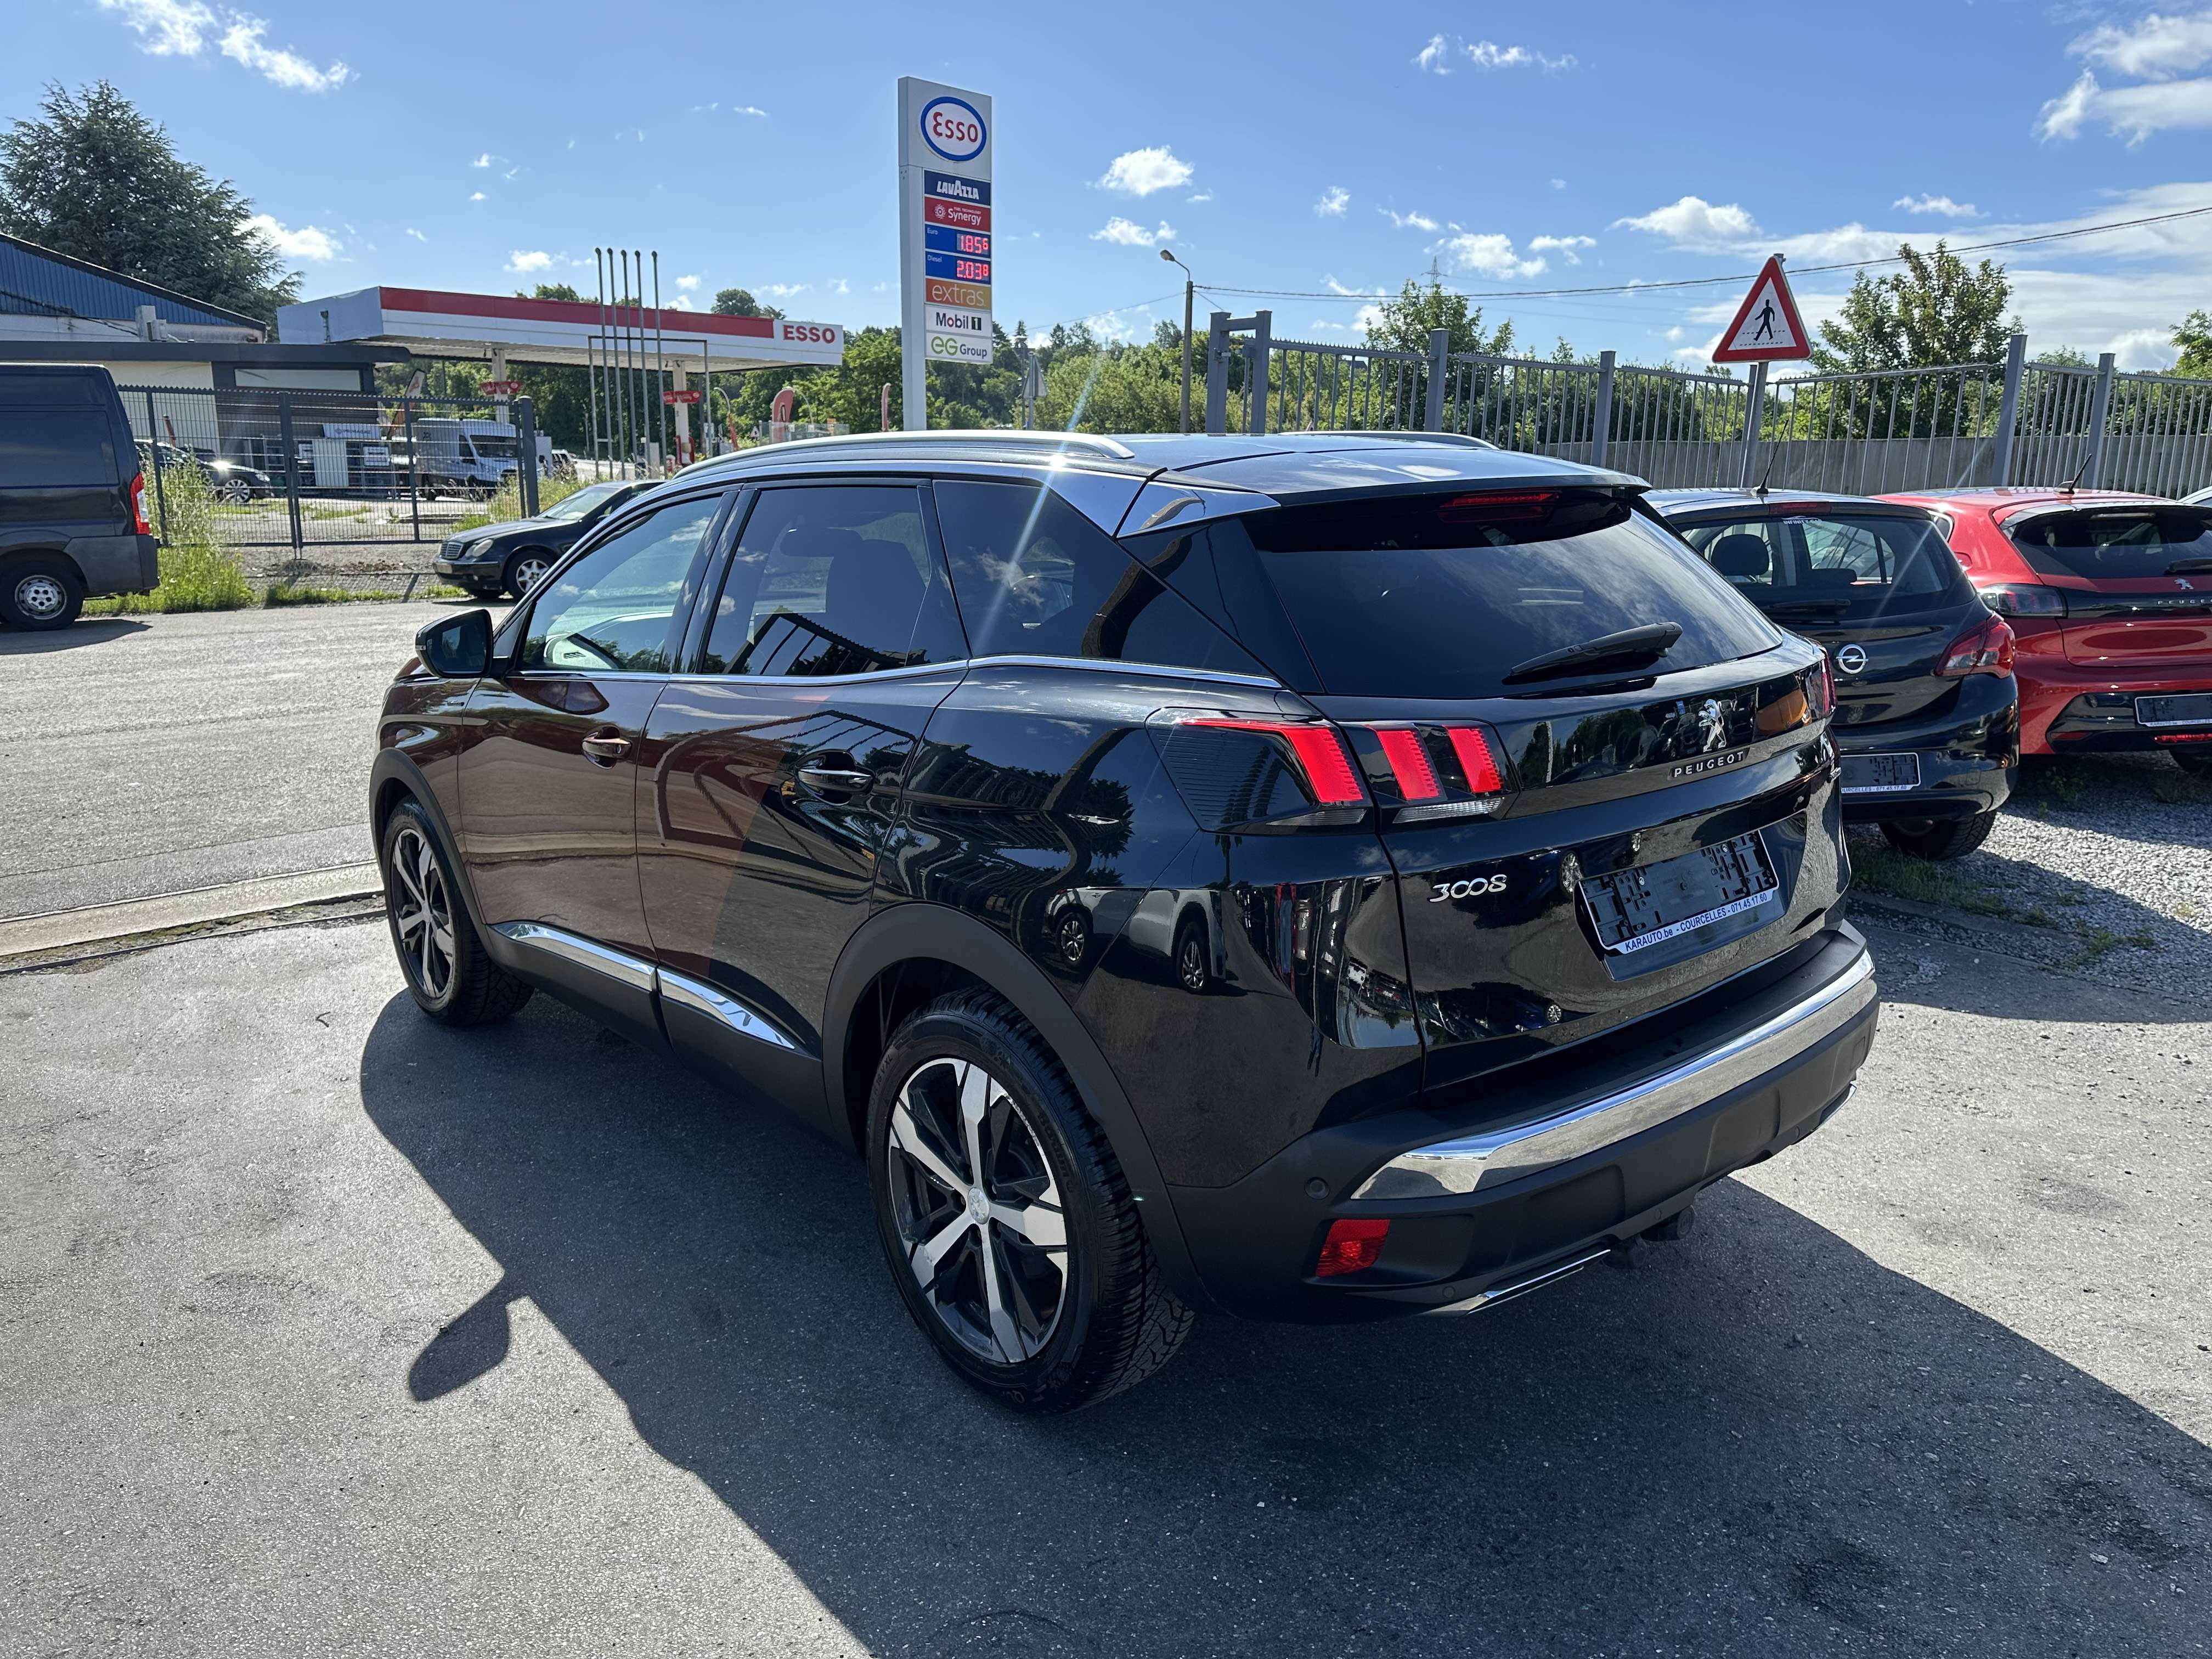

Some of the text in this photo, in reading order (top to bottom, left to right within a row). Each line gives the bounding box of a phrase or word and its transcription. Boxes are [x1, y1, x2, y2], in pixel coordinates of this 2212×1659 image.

[936, 180, 979, 200] LAVAZZA
[948, 208, 981, 225] Synergy
[932, 284, 984, 306] extras
[936, 312, 980, 330] Mobil 1
[783, 325, 835, 343] ESSO
[960, 344, 987, 359] Group
[1674, 751, 1743, 778] PEUGEOT
[1430, 874, 1507, 902] 3008
[1625, 929, 1673, 951] KARAUTO.be
[1680, 907, 1726, 932] COURCELLES
[1731, 893, 1767, 913] 071.45.17.60
